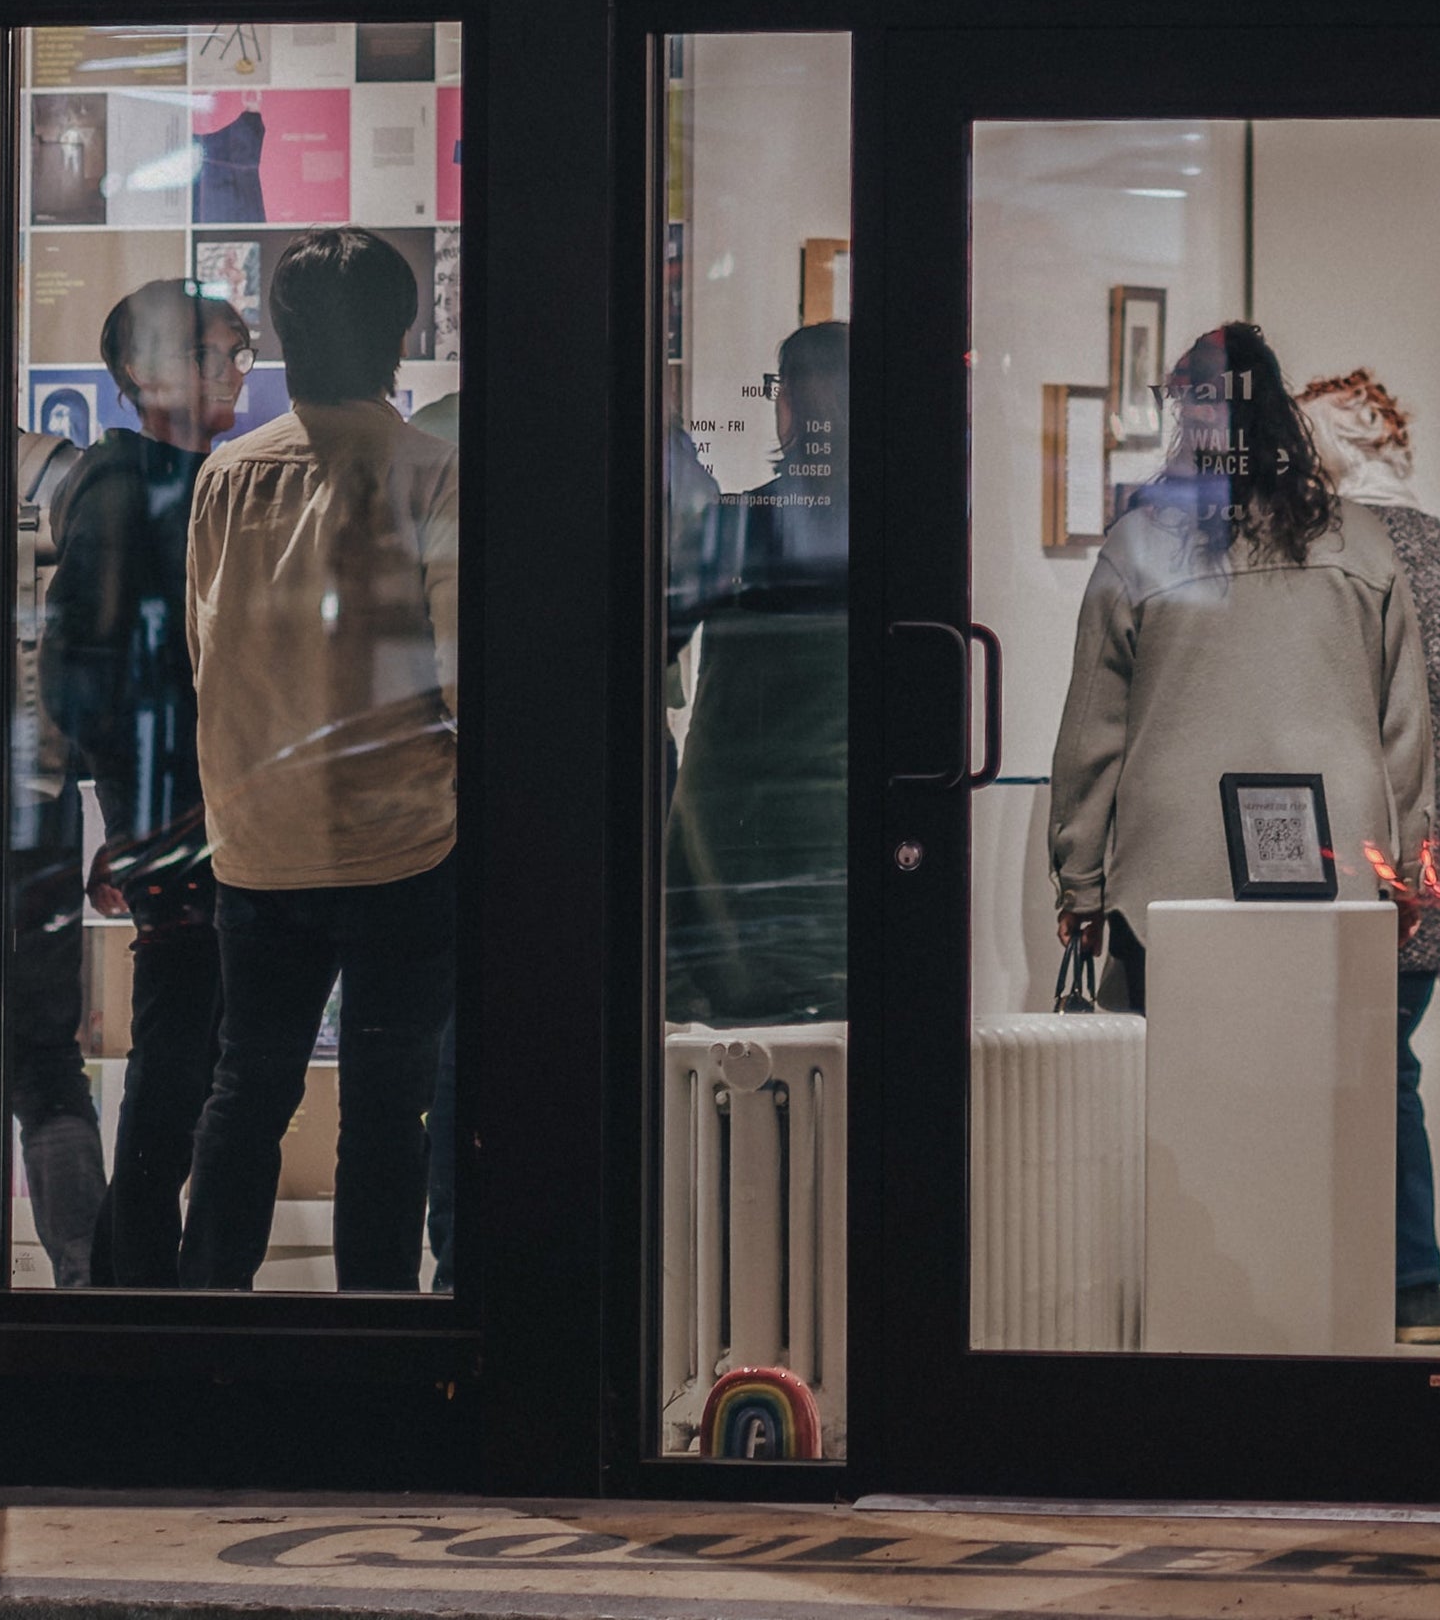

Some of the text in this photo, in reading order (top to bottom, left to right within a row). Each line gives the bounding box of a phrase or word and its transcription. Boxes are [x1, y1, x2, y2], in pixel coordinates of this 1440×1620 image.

[1148, 369, 1253, 411] wall
[690, 420, 716, 432] MON
[728, 420, 745, 432] FRI
[806, 421, 832, 433] 10-6
[1189, 428, 1250, 452] WALL
[806, 443, 831, 455] 10-5
[788, 464, 831, 477] CLOSED
[1193, 455, 1250, 476] SPACE
